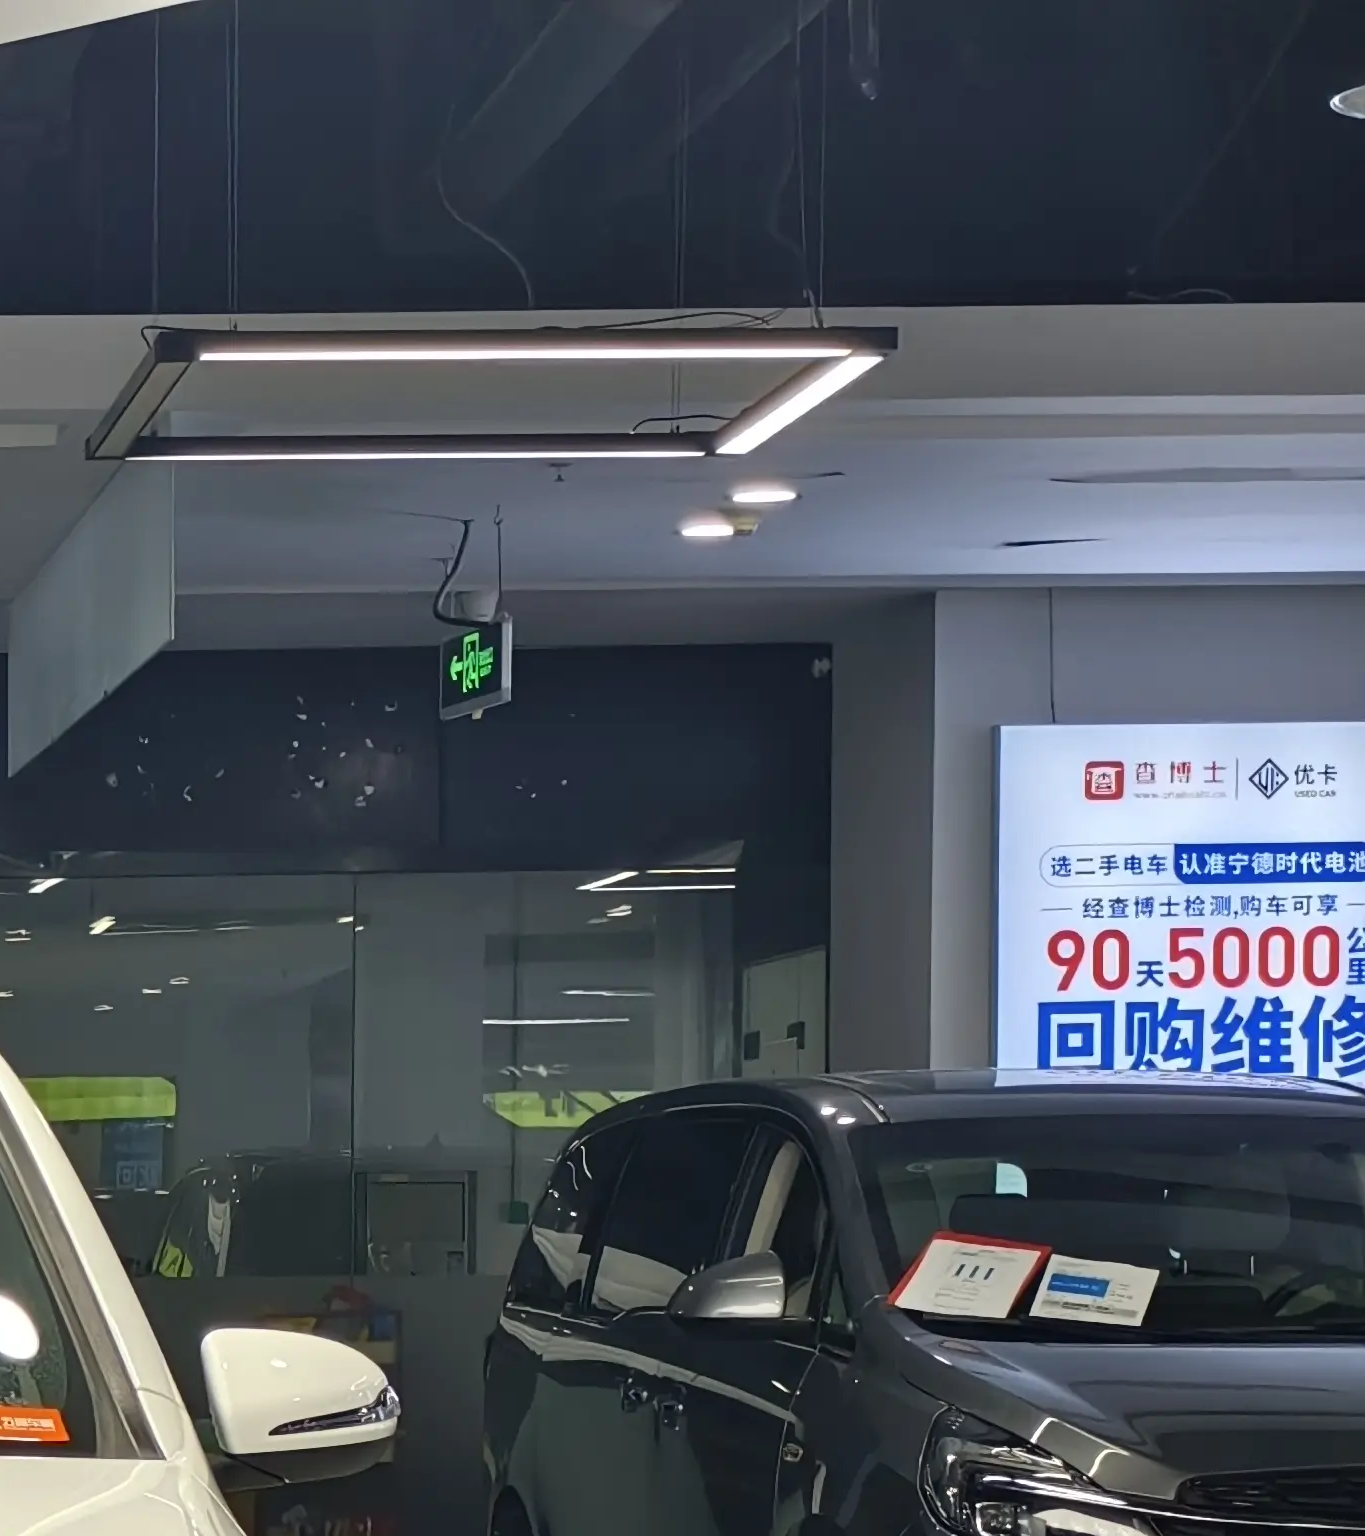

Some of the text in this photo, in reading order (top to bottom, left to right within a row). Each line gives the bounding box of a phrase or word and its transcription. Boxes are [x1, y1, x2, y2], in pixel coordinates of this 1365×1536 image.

[1294, 763, 1338, 786] 优卡
[1050, 854, 1169, 878] 选二手电车
